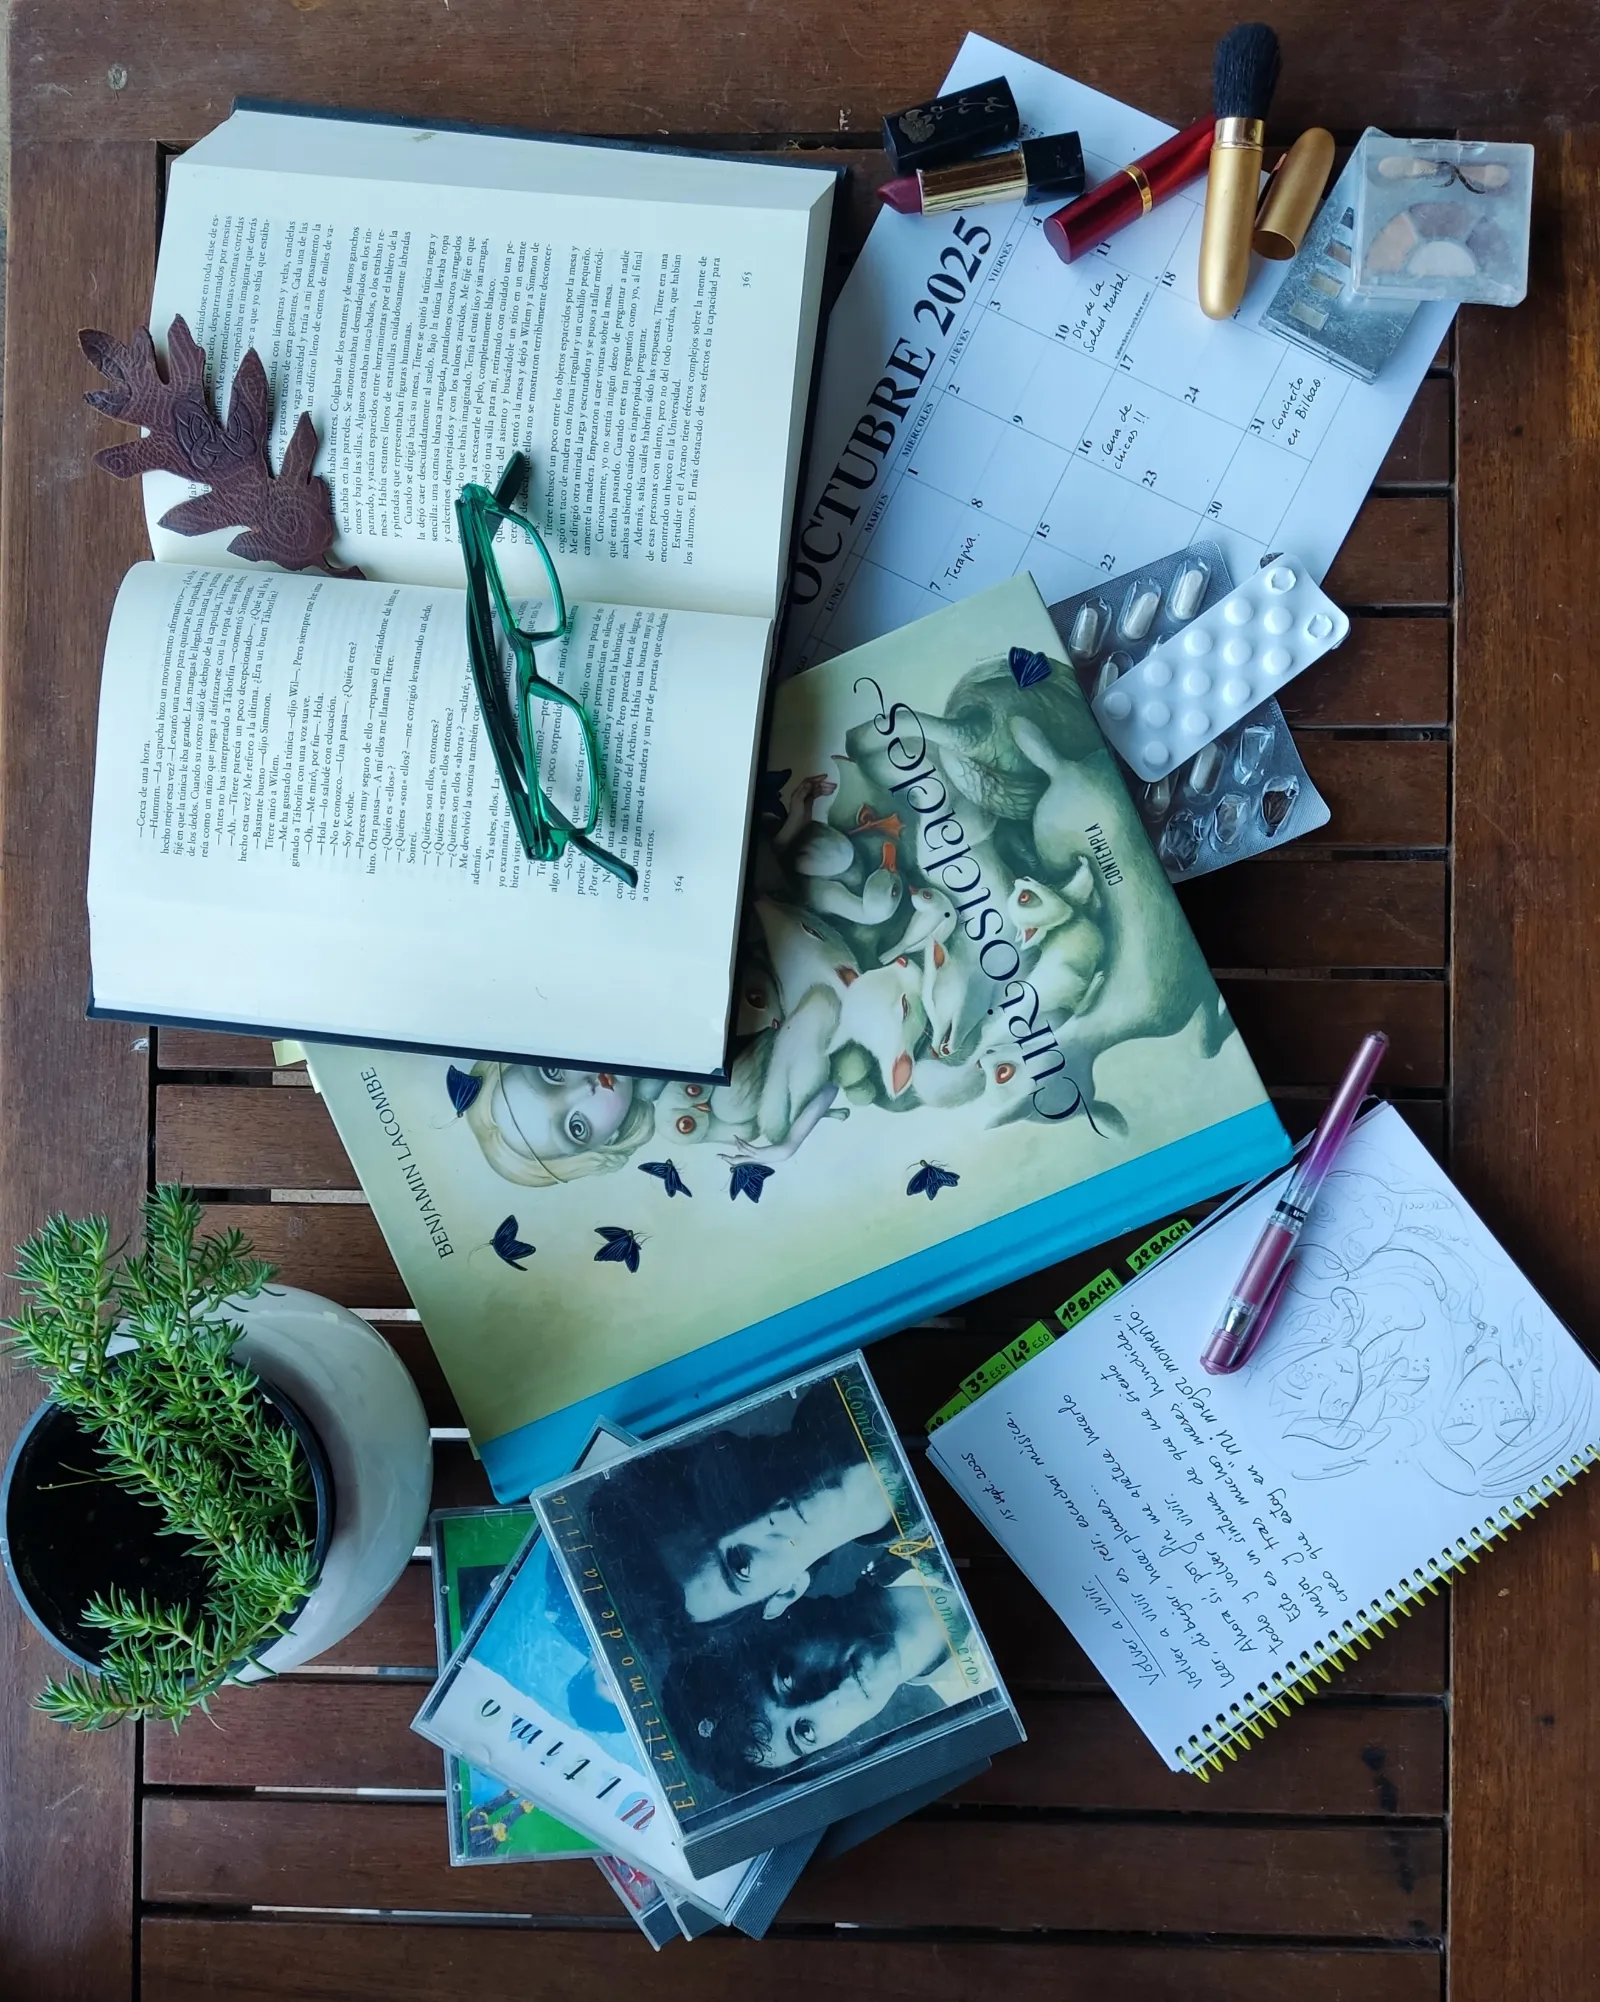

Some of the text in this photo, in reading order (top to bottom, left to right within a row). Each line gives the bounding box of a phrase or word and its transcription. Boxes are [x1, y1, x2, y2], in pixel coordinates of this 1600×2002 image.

[741, 271, 752, 287] 365
[1071, 319, 1088, 339] Día
[1084, 301, 1095, 316] de
[1082, 315, 1106, 353] Salud
[398, 321, 413, 365] humanas.
[906, 215, 1043, 475] 1 2 3 4
[395, 366, 408, 398] figuras
[682, 257, 721, 565] los alumnos. El más destacado de esos efectos es la capacidad para
[791, 216, 993, 606] OCTUBRE 2025
[928, 239, 1112, 591] 7 8 9 10 11
[1035, 270, 1176, 538] 15 16 17 18
[1271, 377, 1303, 430] Concierto
[1286, 376, 1326, 445] en Bilbao.
[393, 400, 404, 467] representaban
[824, 240, 1013, 612] LUNES MARTES MIERCOLES JUEVES VIERNES
[1100, 403, 1132, 455] Cena de
[1114, 429, 1138, 470] chicas
[1206, 417, 1265, 518] 30 31
[393, 468, 402, 487] que
[659, 378, 681, 563] encontrado un hueco en la Universidad.
[1099, 385, 1200, 571] 22 23 24
[390, 489, 401, 530] pintadas
[139, 739, 150, 764] hora.
[268, 753, 279, 787] Wilem.
[137, 786, 148, 798] de
[141, 766, 149, 784] una
[267, 797, 276, 820] miró
[343, 790, 355, 827] Kvothe.
[263, 822, 275, 850] Títere
[405, 831, 417, 864] Sonreí.
[645, 828, 655, 867] cuartos.
[1083, 822, 1123, 887] CONTEMPLA
[642, 868, 651, 894] otros
[673, 875, 684, 892] 364
[359, 1066, 454, 1259] BENJAMIN LACOMBE
[1148, 1219, 1190, 1256] BACH
[1075, 1275, 1116, 1312] BACH
[1099, 1364, 1140, 1402] siento
[1174, 1375, 1217, 1423] mejor
[1056, 1393, 1100, 1446] hacerlo
[1140, 1407, 1161, 1431] me
[960, 1452, 986, 1479] 2025
[1161, 1436, 1187, 1461] que
[1101, 1447, 1142, 1498] apetece
[1116, 1329, 1329, 1618] mejor y tras muchos meses hundida
[1185, 1466, 1203, 1485] de
[1246, 1464, 1264, 1485] en
[1043, 1473, 1089, 1528] escuchar
[1141, 1502, 1160, 1524] me
[1266, 1487, 1292, 1524] estoy
[1157, 1528, 1198, 1557] fin
[1246, 1548, 1261, 1565] un
[1296, 1530, 1323, 1560] que
[1115, 1566, 1130, 1584] es
[1130, 1548, 1161, 1585] hacer
[1163, 1492, 1284, 1655] todo y volver a vivir.
[1183, 1560, 1212, 1584] por
[1262, 1569, 1277, 1587] es
[1321, 1569, 1348, 1602] creo
[1130, 1592, 1157, 1622] vivir
[1277, 1591, 1301, 1623] Esto
[1080, 1580, 1159, 1686] Volver a vivir.
[1159, 1627, 1169, 1637] a
[1220, 1609, 1258, 1652] Ahora
[550, 1491, 696, 1813] El último de la fila
